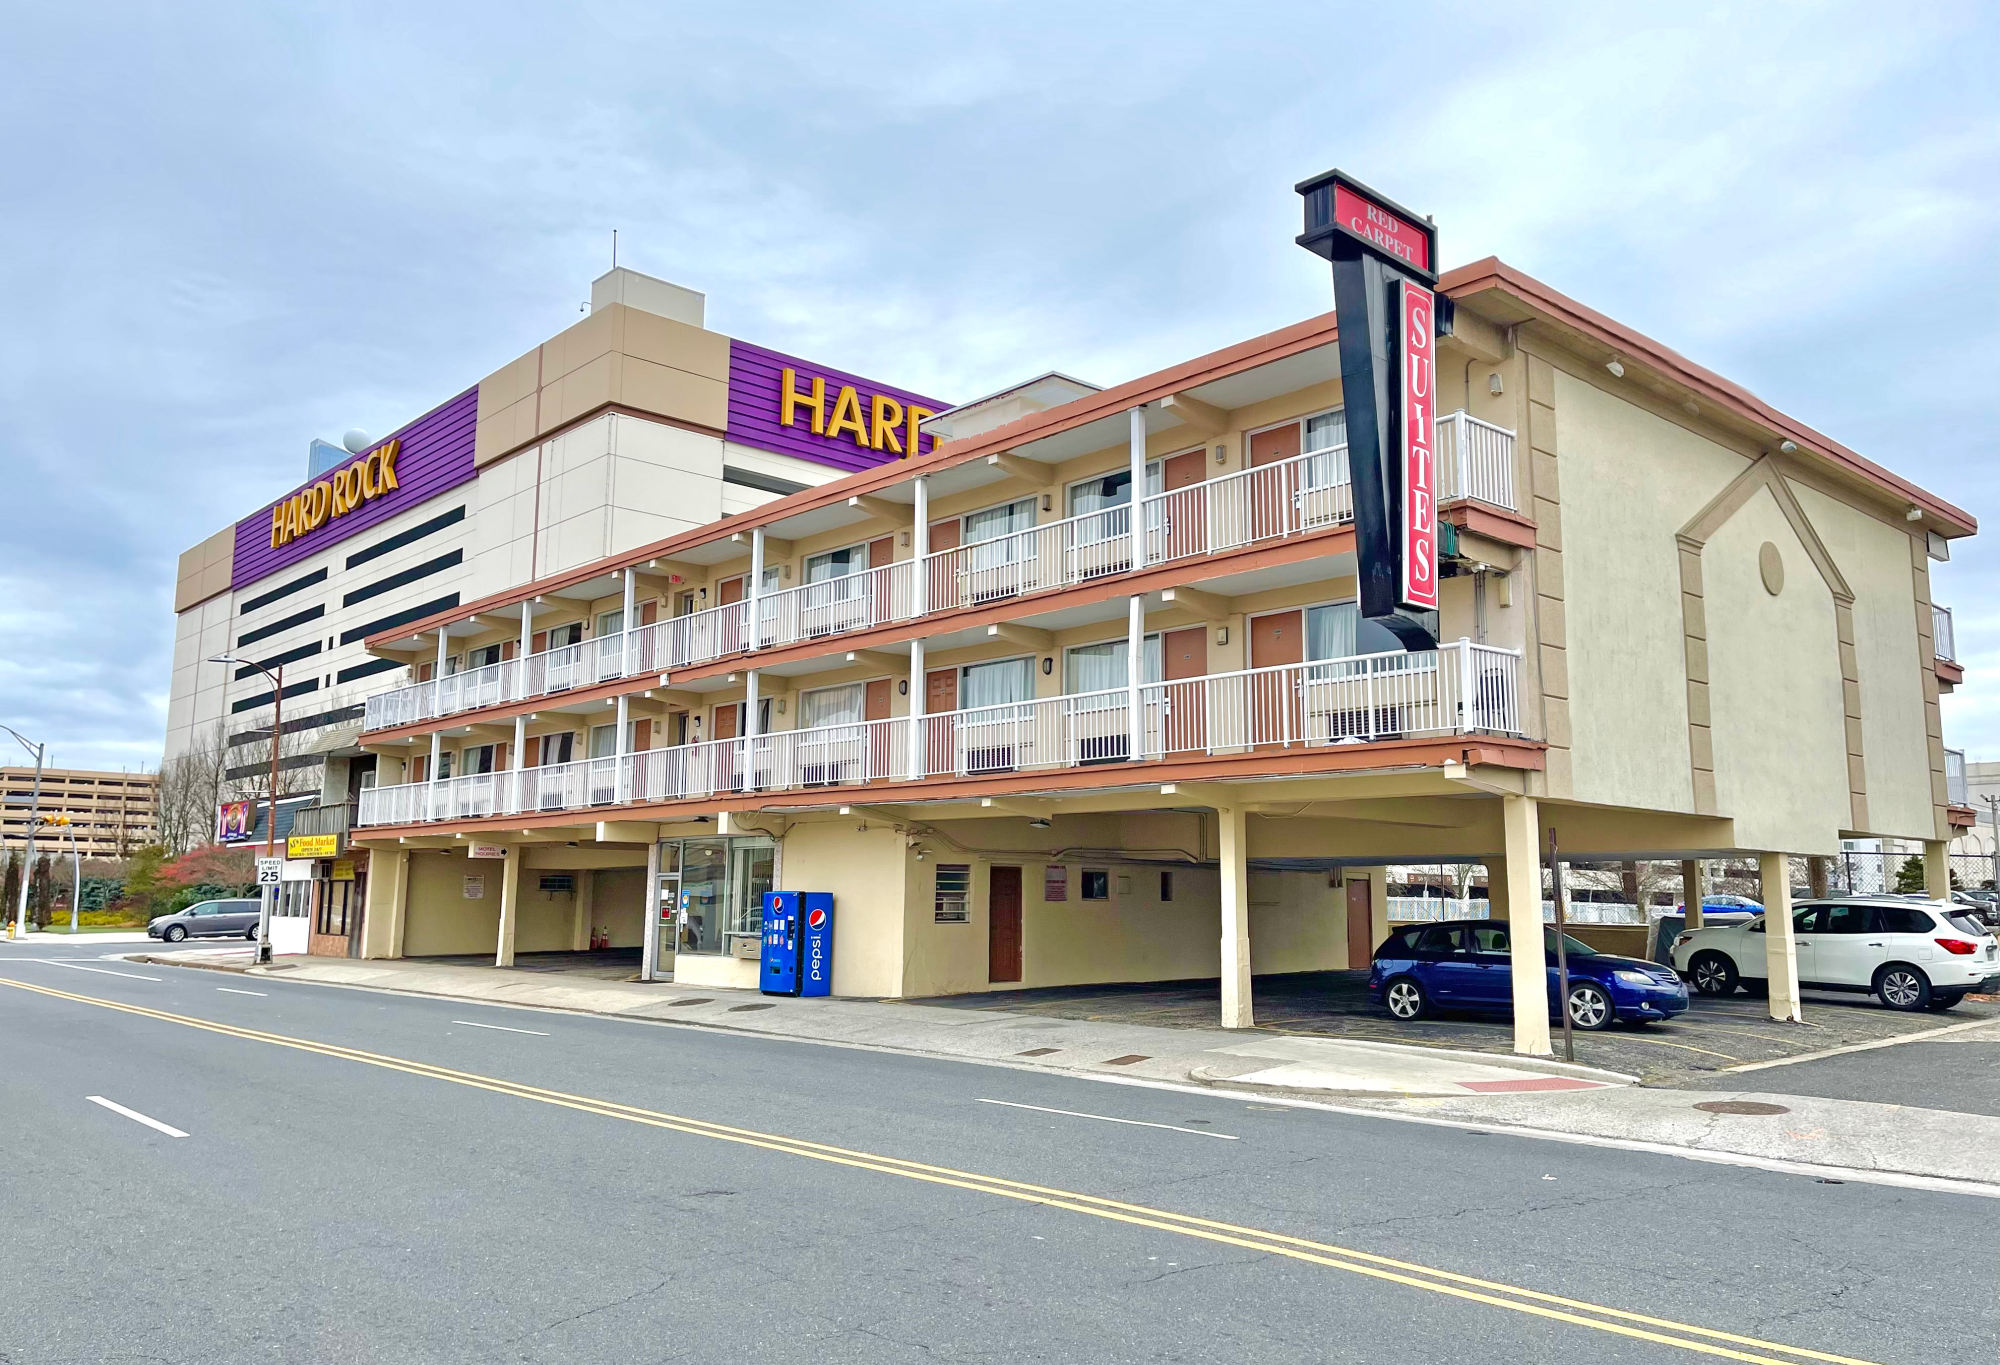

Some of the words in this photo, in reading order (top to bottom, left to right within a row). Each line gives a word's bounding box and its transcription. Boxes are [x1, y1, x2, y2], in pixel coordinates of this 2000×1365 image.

[1351, 216, 1414, 262] CARPET
[1367, 204, 1399, 233] RED
[1410, 307, 1431, 582] SUITES
[270, 481, 331, 549] HARD
[331, 439, 402, 518] ROCK
[300, 837, 314, 847] Food
[315, 836, 335, 847] Market
[260, 871, 279, 882] 25
[811, 935, 822, 981] pepsi
